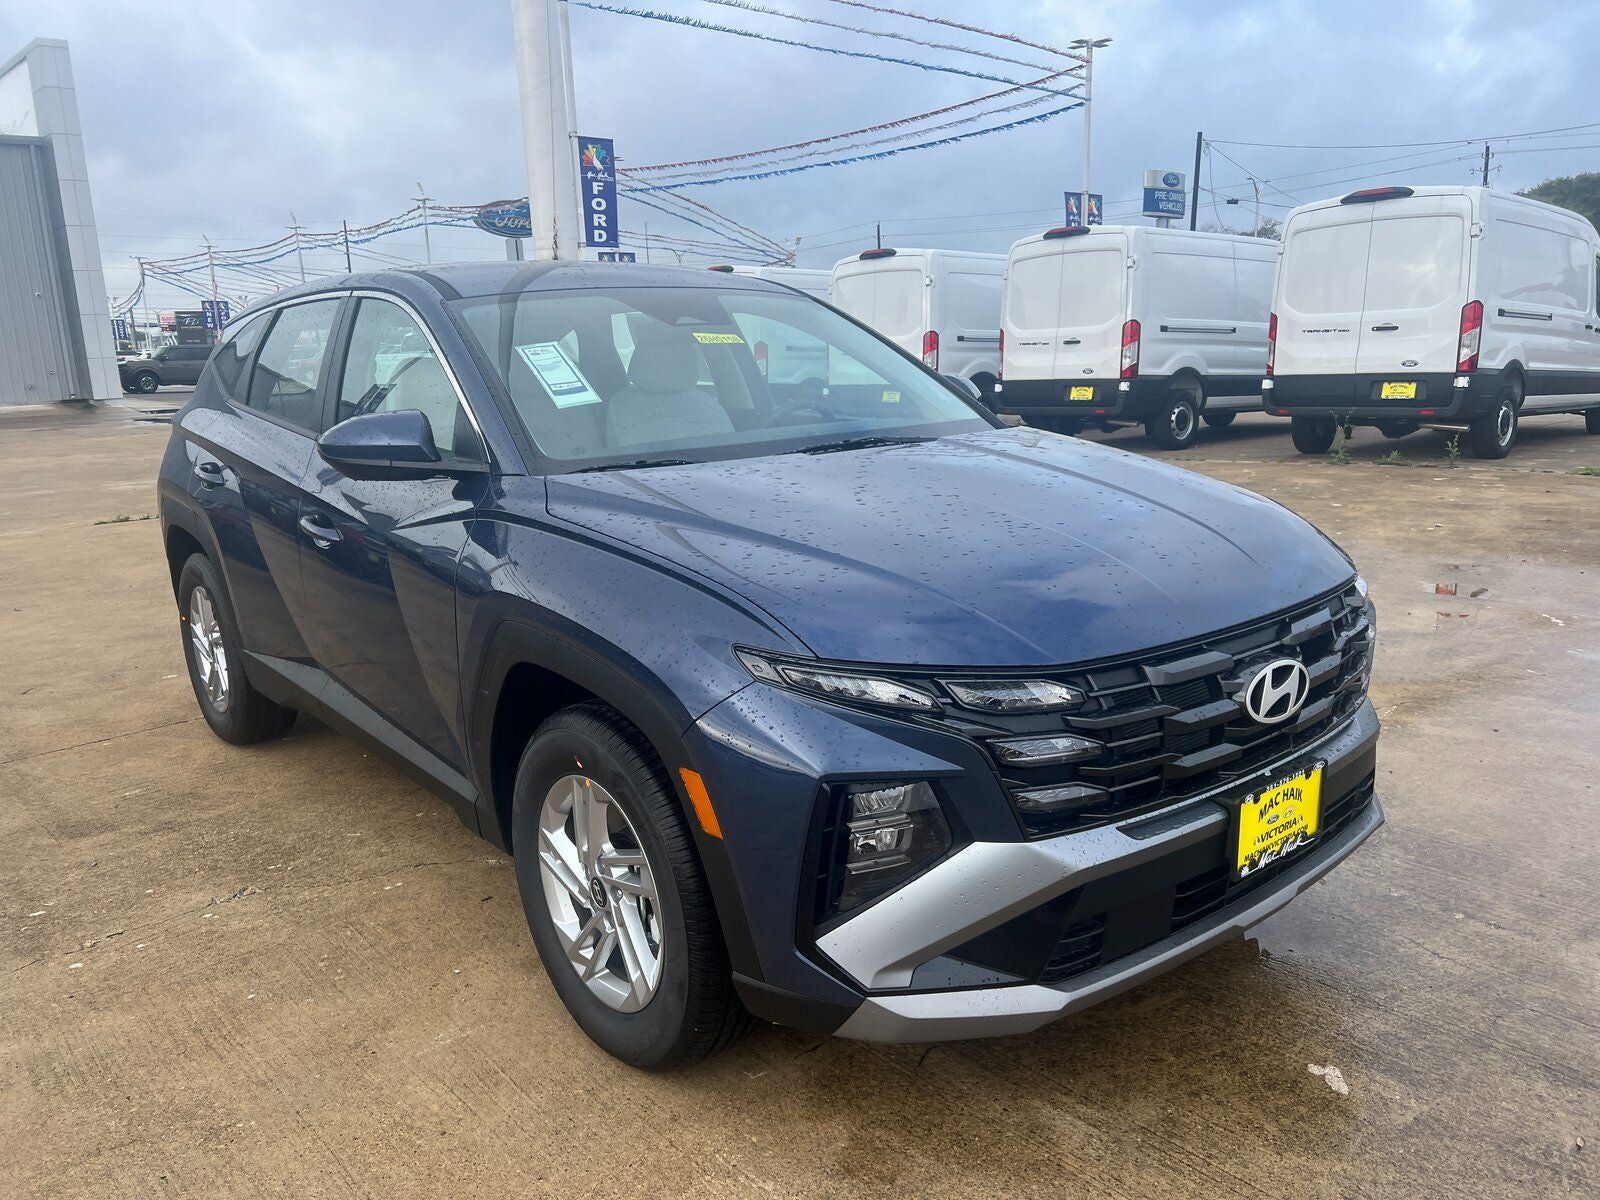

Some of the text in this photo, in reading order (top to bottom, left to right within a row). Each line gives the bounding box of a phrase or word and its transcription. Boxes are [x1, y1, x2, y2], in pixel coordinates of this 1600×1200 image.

[591, 181, 608, 242] FORD
[1158, 201, 1183, 211] VEHICLES
[206, 311, 214, 328] NEW
[1258, 792, 1281, 822] MAC
[1282, 787, 1303, 803] HAIK
[1260, 816, 1297, 843] VICTORIA
